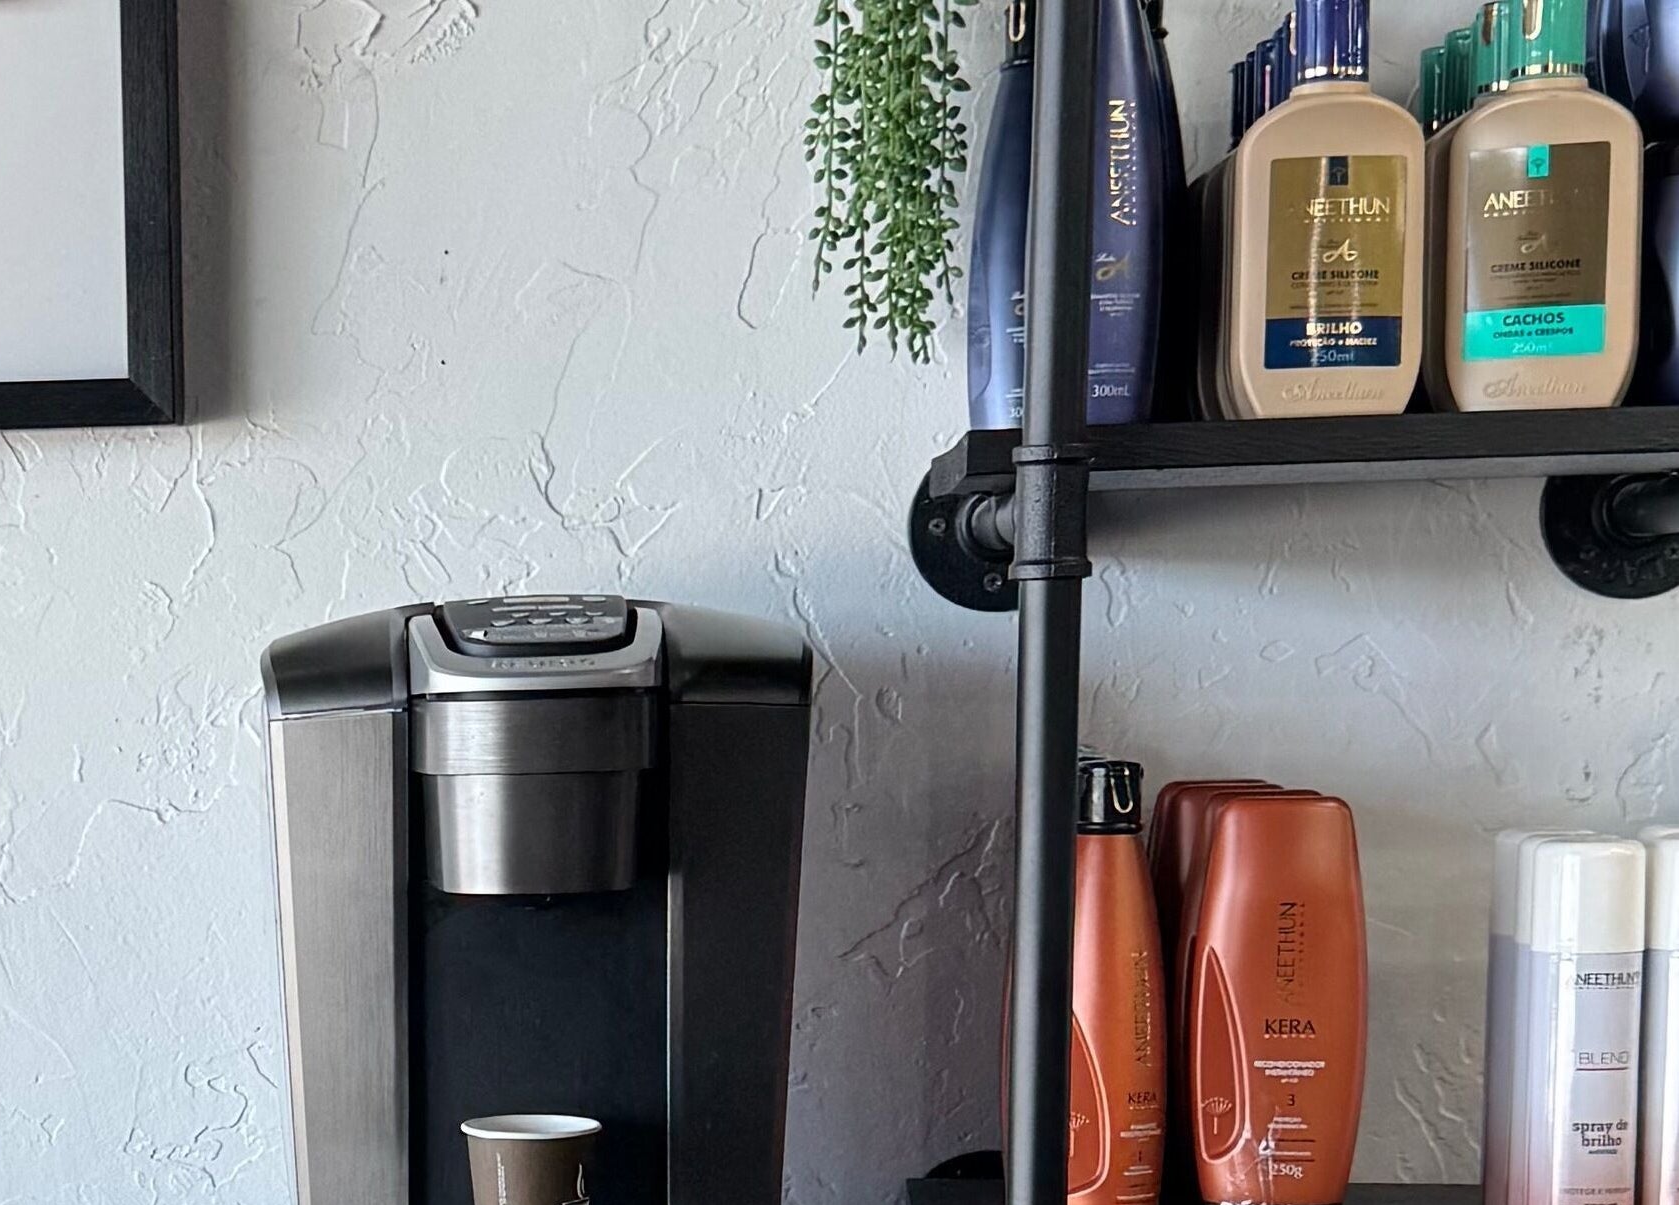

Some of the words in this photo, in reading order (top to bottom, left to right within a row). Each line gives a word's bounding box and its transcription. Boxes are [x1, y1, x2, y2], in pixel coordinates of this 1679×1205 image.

[1293, 197, 1390, 217] NEETHUN
[1484, 188, 1561, 211] ANEET
[1529, 258, 1582, 271] SILICONE
[1503, 312, 1566, 327] CACHOS
[1306, 321, 1363, 336] BRILHO
[1264, 1018, 1317, 1035] KERA
[1127, 1091, 1157, 1104] KERA
[1572, 1122, 1614, 1135] spray
[1581, 1134, 1623, 1147] brilho
